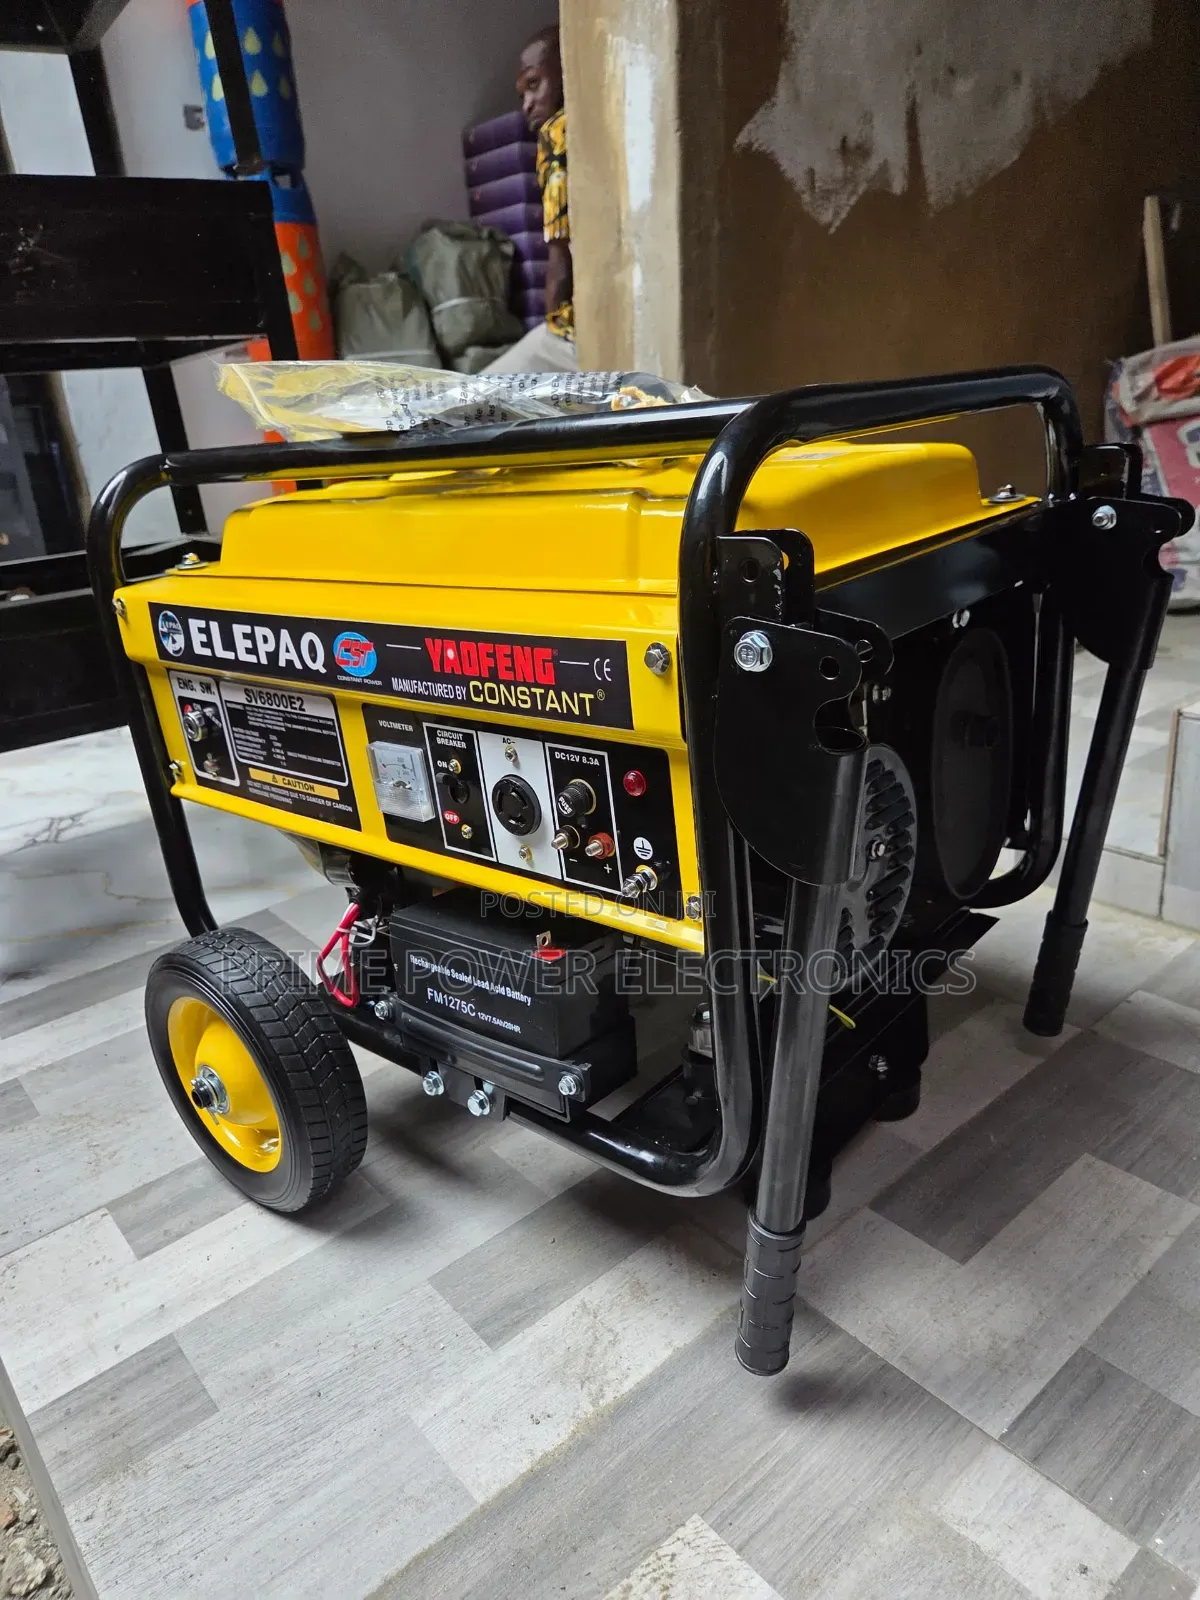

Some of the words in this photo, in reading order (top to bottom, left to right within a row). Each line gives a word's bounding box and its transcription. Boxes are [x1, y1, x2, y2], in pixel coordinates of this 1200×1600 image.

[188, 618, 327, 674] ELEPAQ
[335, 639, 374, 668] CST
[424, 638, 556, 685] YAOFENG
[177, 678, 197, 692] ENG.
[199, 681, 216, 696] SW.
[391, 677, 455, 699] MANUFACTURED
[455, 685, 467, 700] BY
[244, 688, 307, 712] SV6800E2
[378, 720, 414, 732] VOLTMETER
[436, 729, 463, 741] CIRCUIT
[436, 737, 467, 749] BREAKER
[437, 760, 448, 769] ON
[555, 751, 580, 763] DC12V
[582, 756, 600, 766] 8.3A
[282, 777, 315, 793] CAUTION
[558, 796, 573, 814] FUSE
[444, 812, 459, 823] OFF
[410, 954, 451, 977] Rechargeable
[451, 968, 472, 985] Sealed
[472, 976, 490, 991] Lead
[490, 984, 505, 996] Acid
[506, 986, 532, 1007] Battery
[427, 987, 476, 1017] FM1275C
